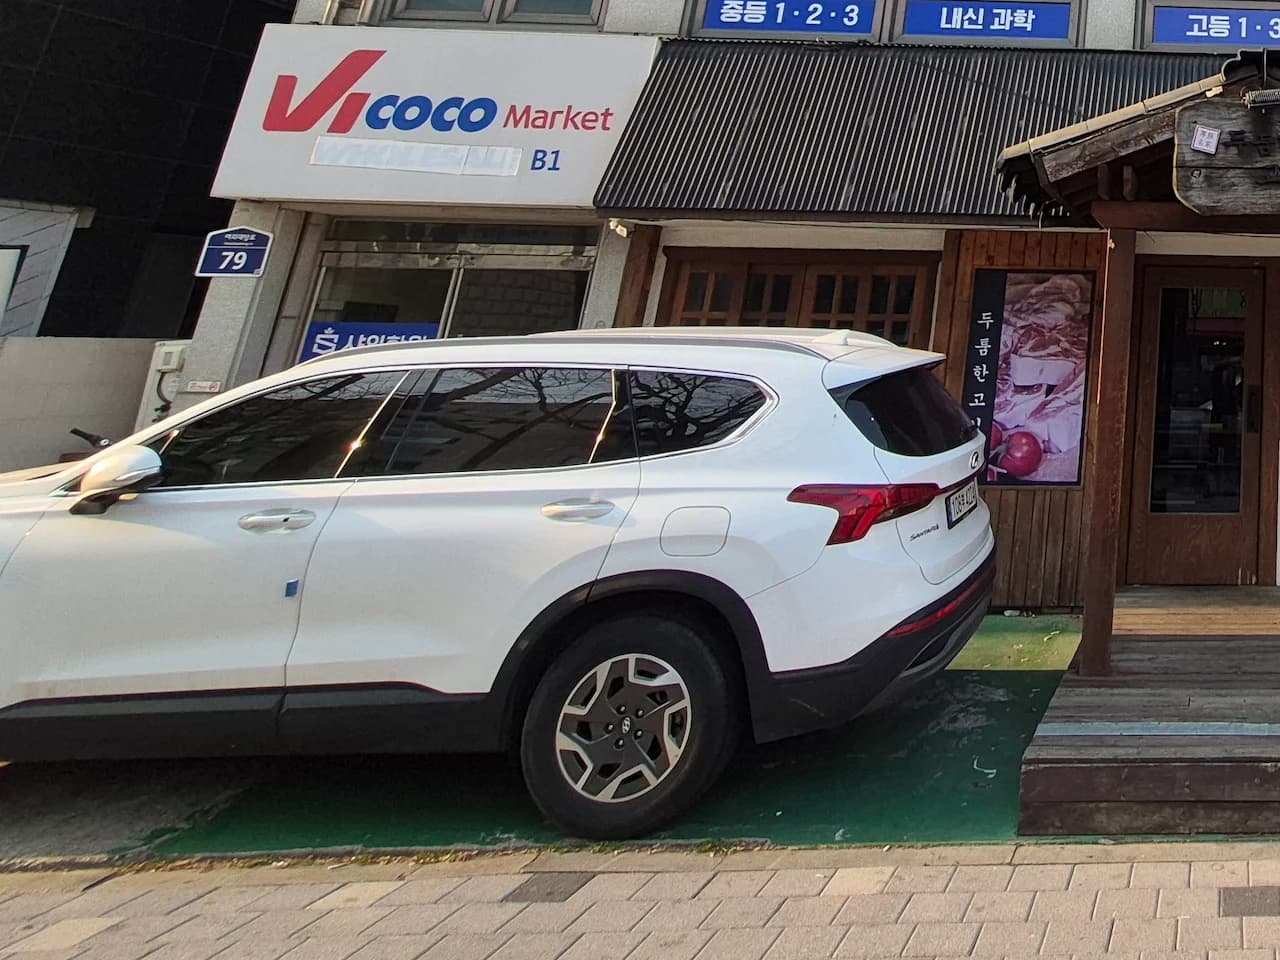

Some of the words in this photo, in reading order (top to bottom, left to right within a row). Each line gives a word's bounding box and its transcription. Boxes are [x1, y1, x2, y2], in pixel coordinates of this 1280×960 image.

[720, 0, 767, 24] 중등
[939, 6, 984, 31] 내신
[989, 7, 1036, 32] 과학
[1185, 14, 1231, 39] 고등
[502, 103, 614, 132] Market
[530, 149, 561, 171] B1
[218, 251, 247, 270] 79
